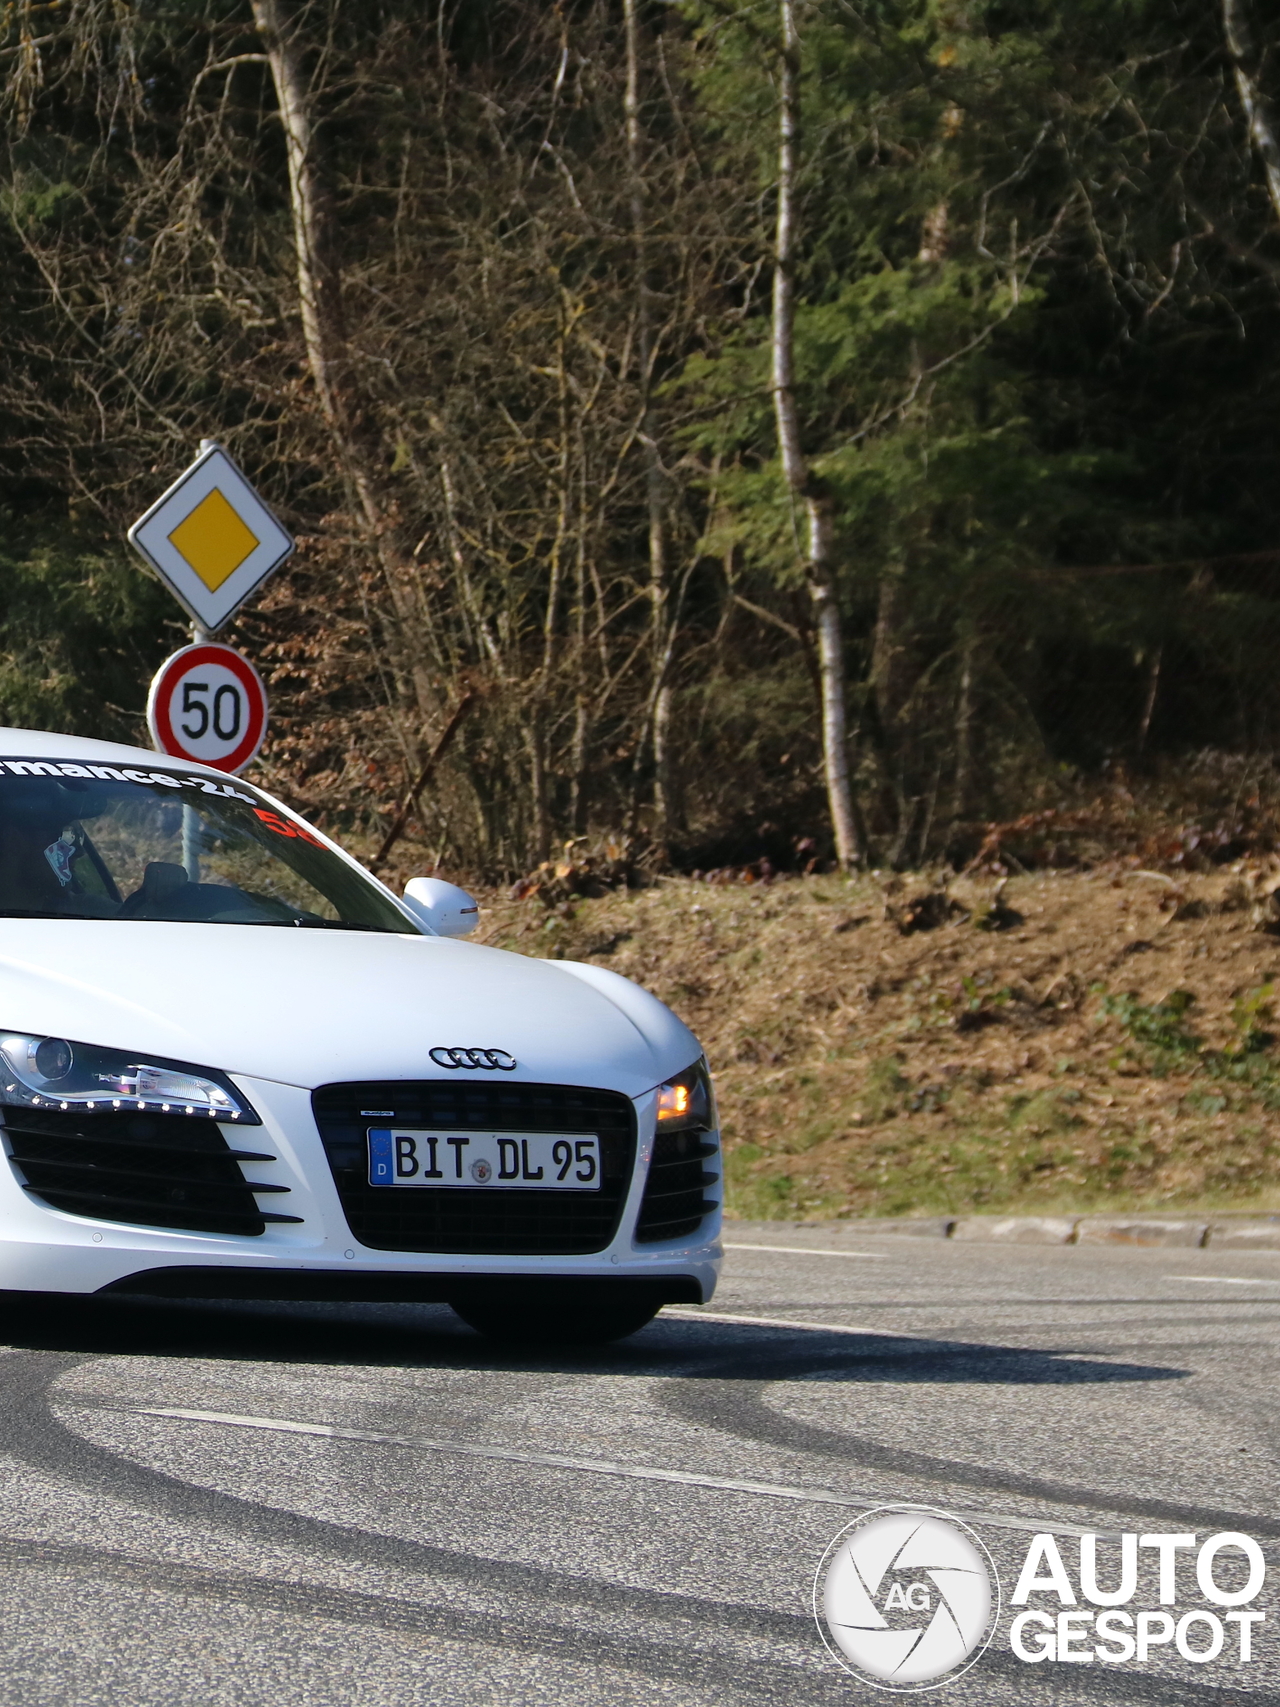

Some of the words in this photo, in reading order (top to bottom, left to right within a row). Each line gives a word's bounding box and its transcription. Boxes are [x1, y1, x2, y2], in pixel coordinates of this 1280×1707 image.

[182, 682, 241, 741] 50
[377, 1163, 387, 1176] D
[395, 1136, 470, 1178] BIT
[497, 1138, 544, 1180] DL
[552, 1140, 596, 1182] 95
